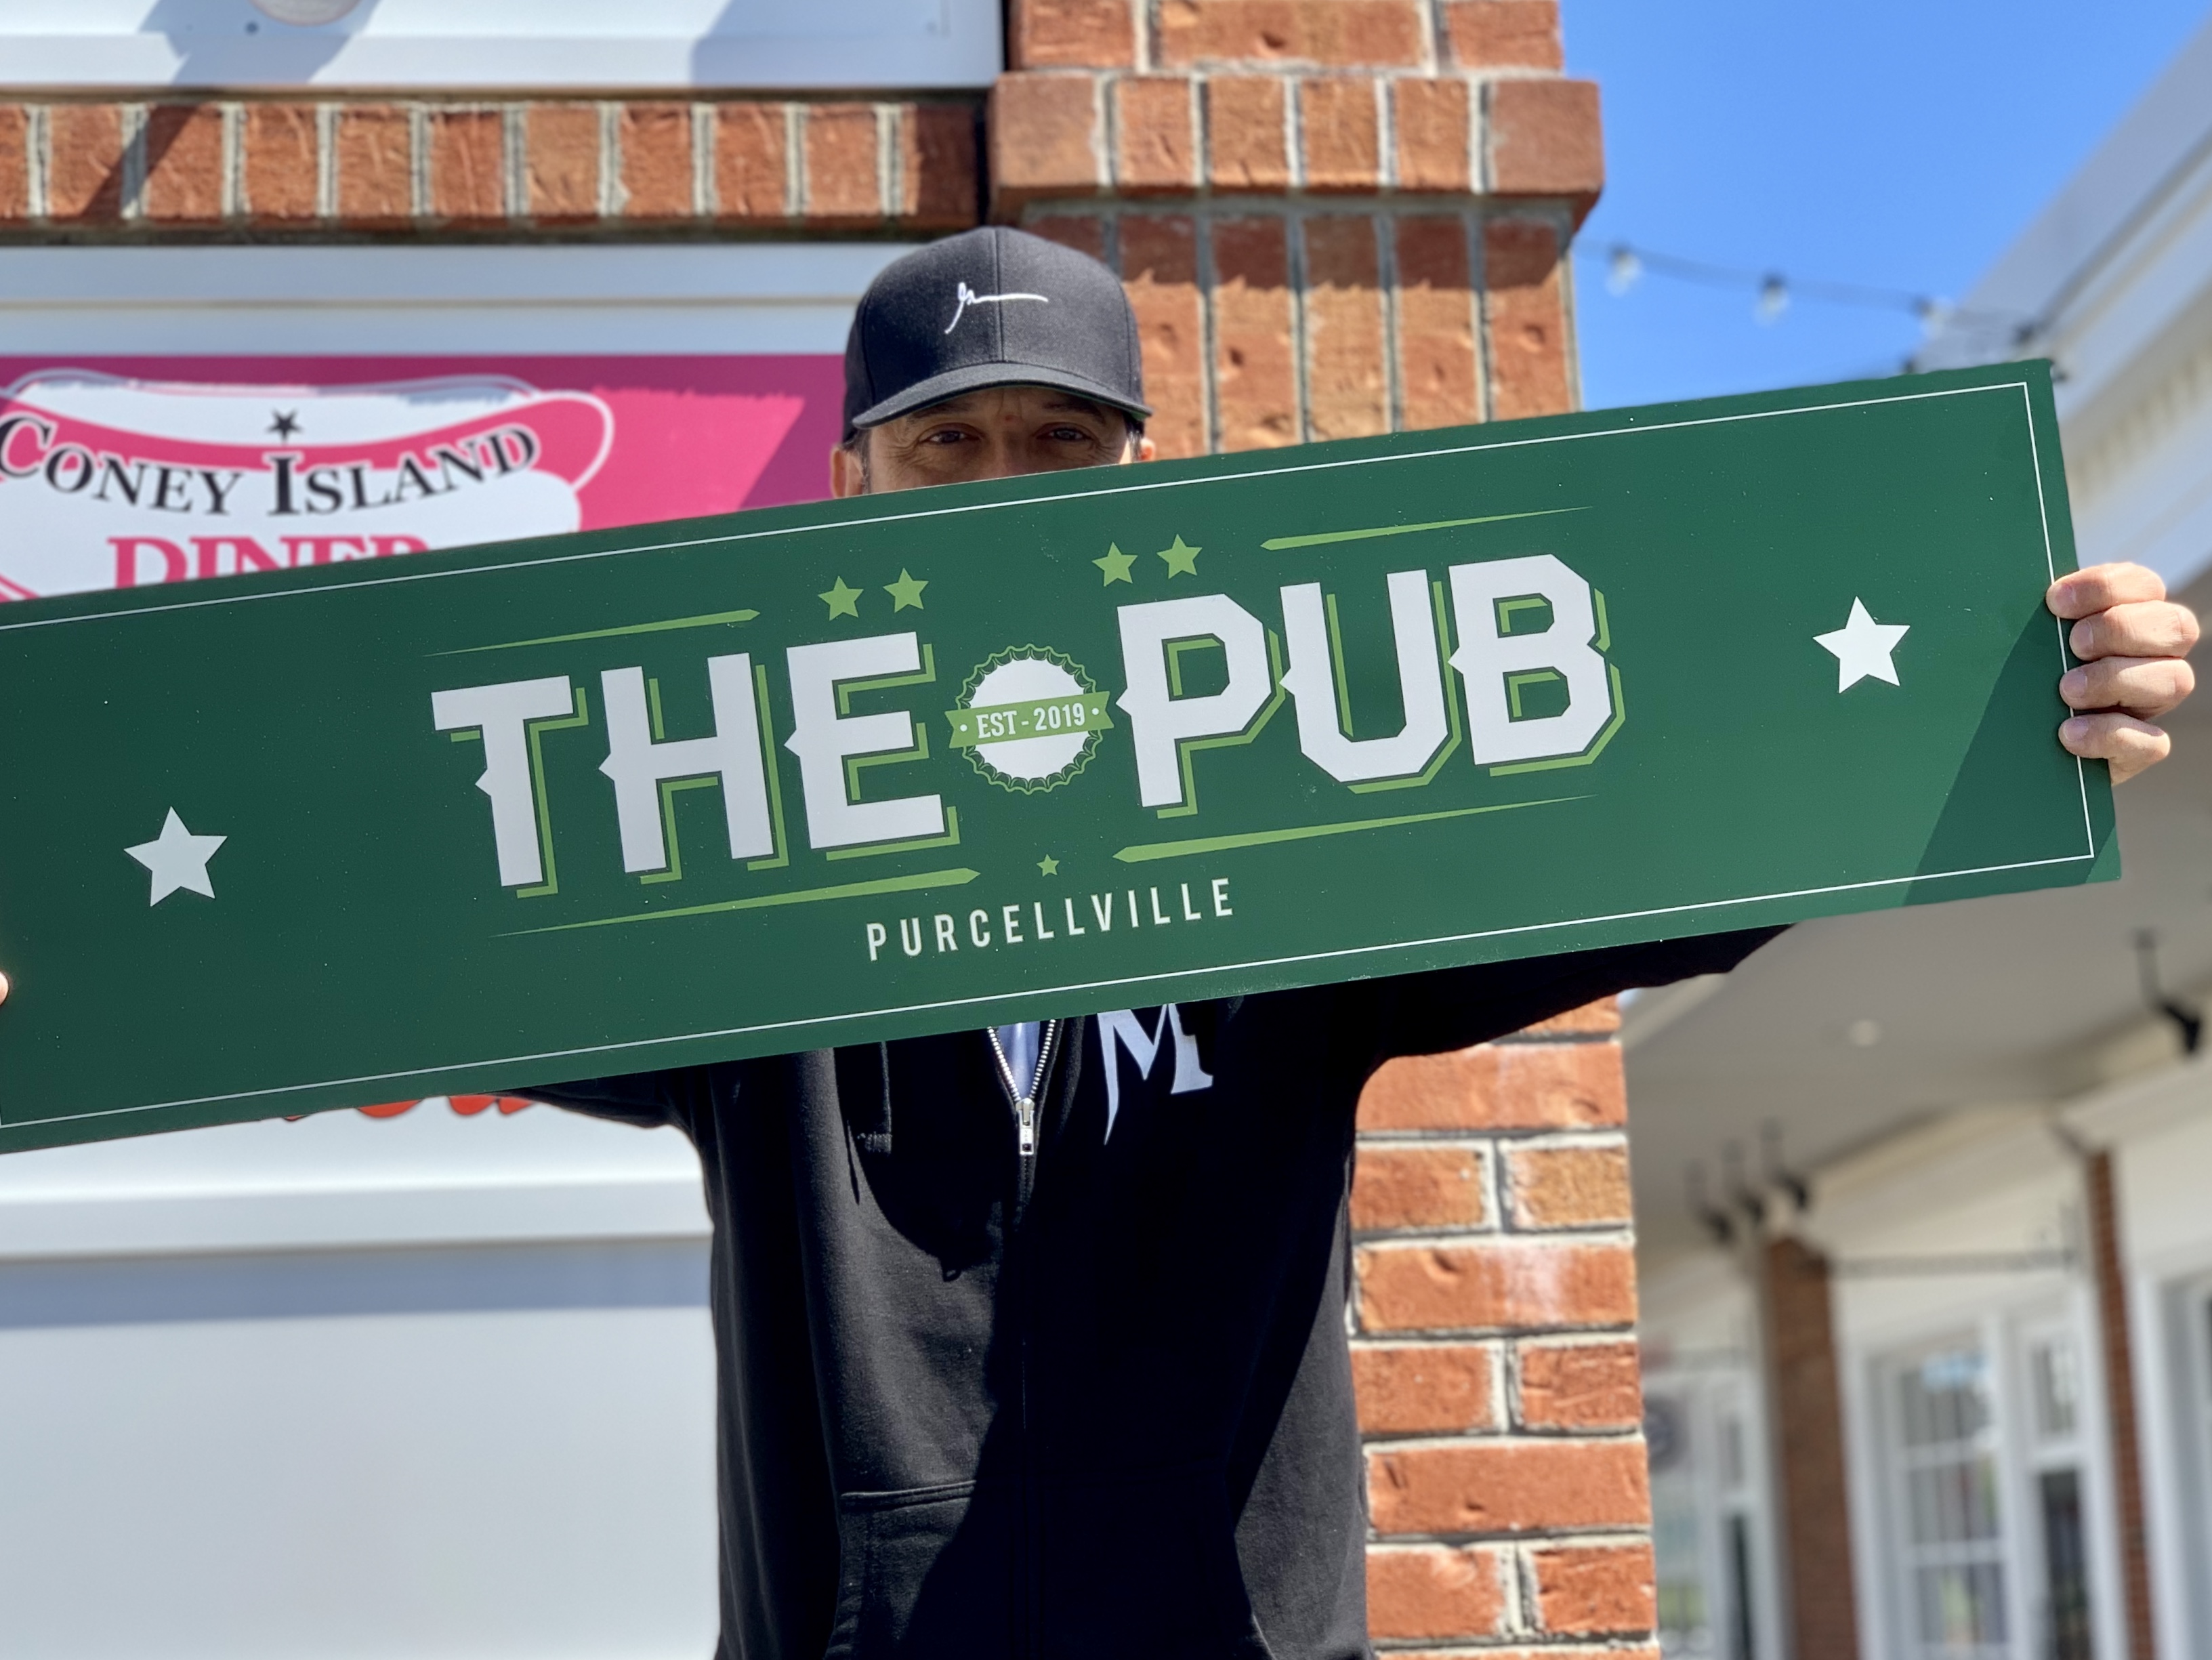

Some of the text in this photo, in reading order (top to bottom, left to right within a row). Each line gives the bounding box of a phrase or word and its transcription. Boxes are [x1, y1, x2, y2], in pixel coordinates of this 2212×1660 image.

[0, 417, 538, 516] CONEY ISLAND
[431, 554, 1625, 898] THE PUB
[867, 877, 1233, 961] PURCELLVILLE
